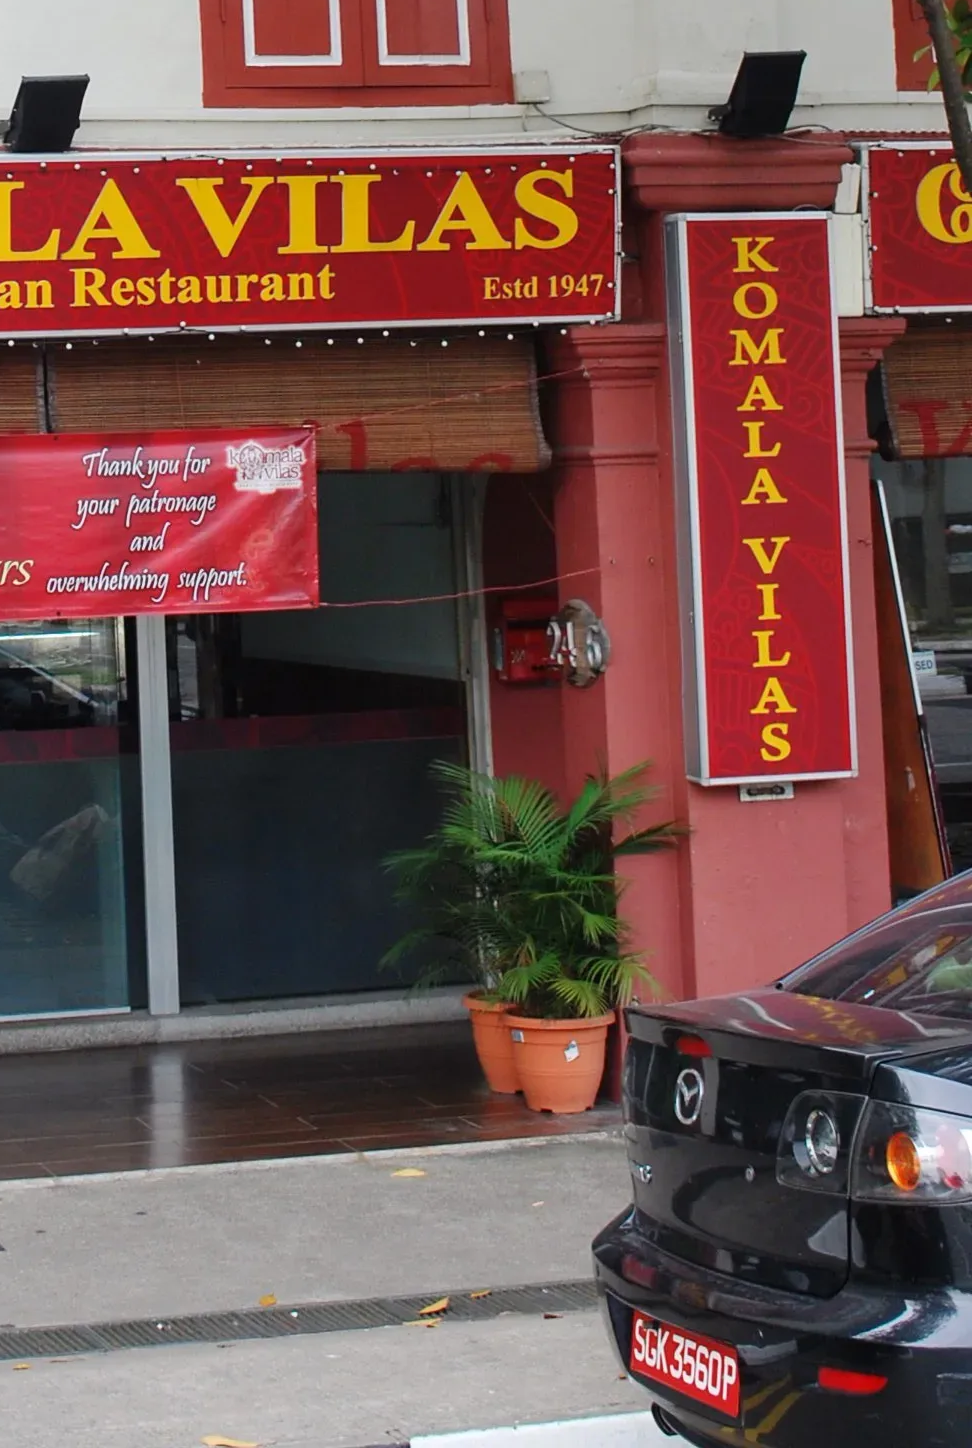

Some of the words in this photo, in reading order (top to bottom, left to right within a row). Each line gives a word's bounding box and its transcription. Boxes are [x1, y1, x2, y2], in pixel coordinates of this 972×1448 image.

[176, 168, 579, 258] VILAS
[69, 263, 336, 308] Restaurant
[483, 276, 538, 300] Estd
[547, 274, 604, 298] 1947
[729, 236, 788, 505] KOMALA
[82, 446, 145, 478] Thank
[141, 457, 180, 489] you
[183, 445, 211, 481] for
[71, 497, 120, 530] your
[125, 492, 217, 528] patronage
[130, 521, 170, 552] and
[46, 560, 169, 602] overwhelming
[176, 562, 247, 601] support.
[742, 536, 797, 762] VILAS
